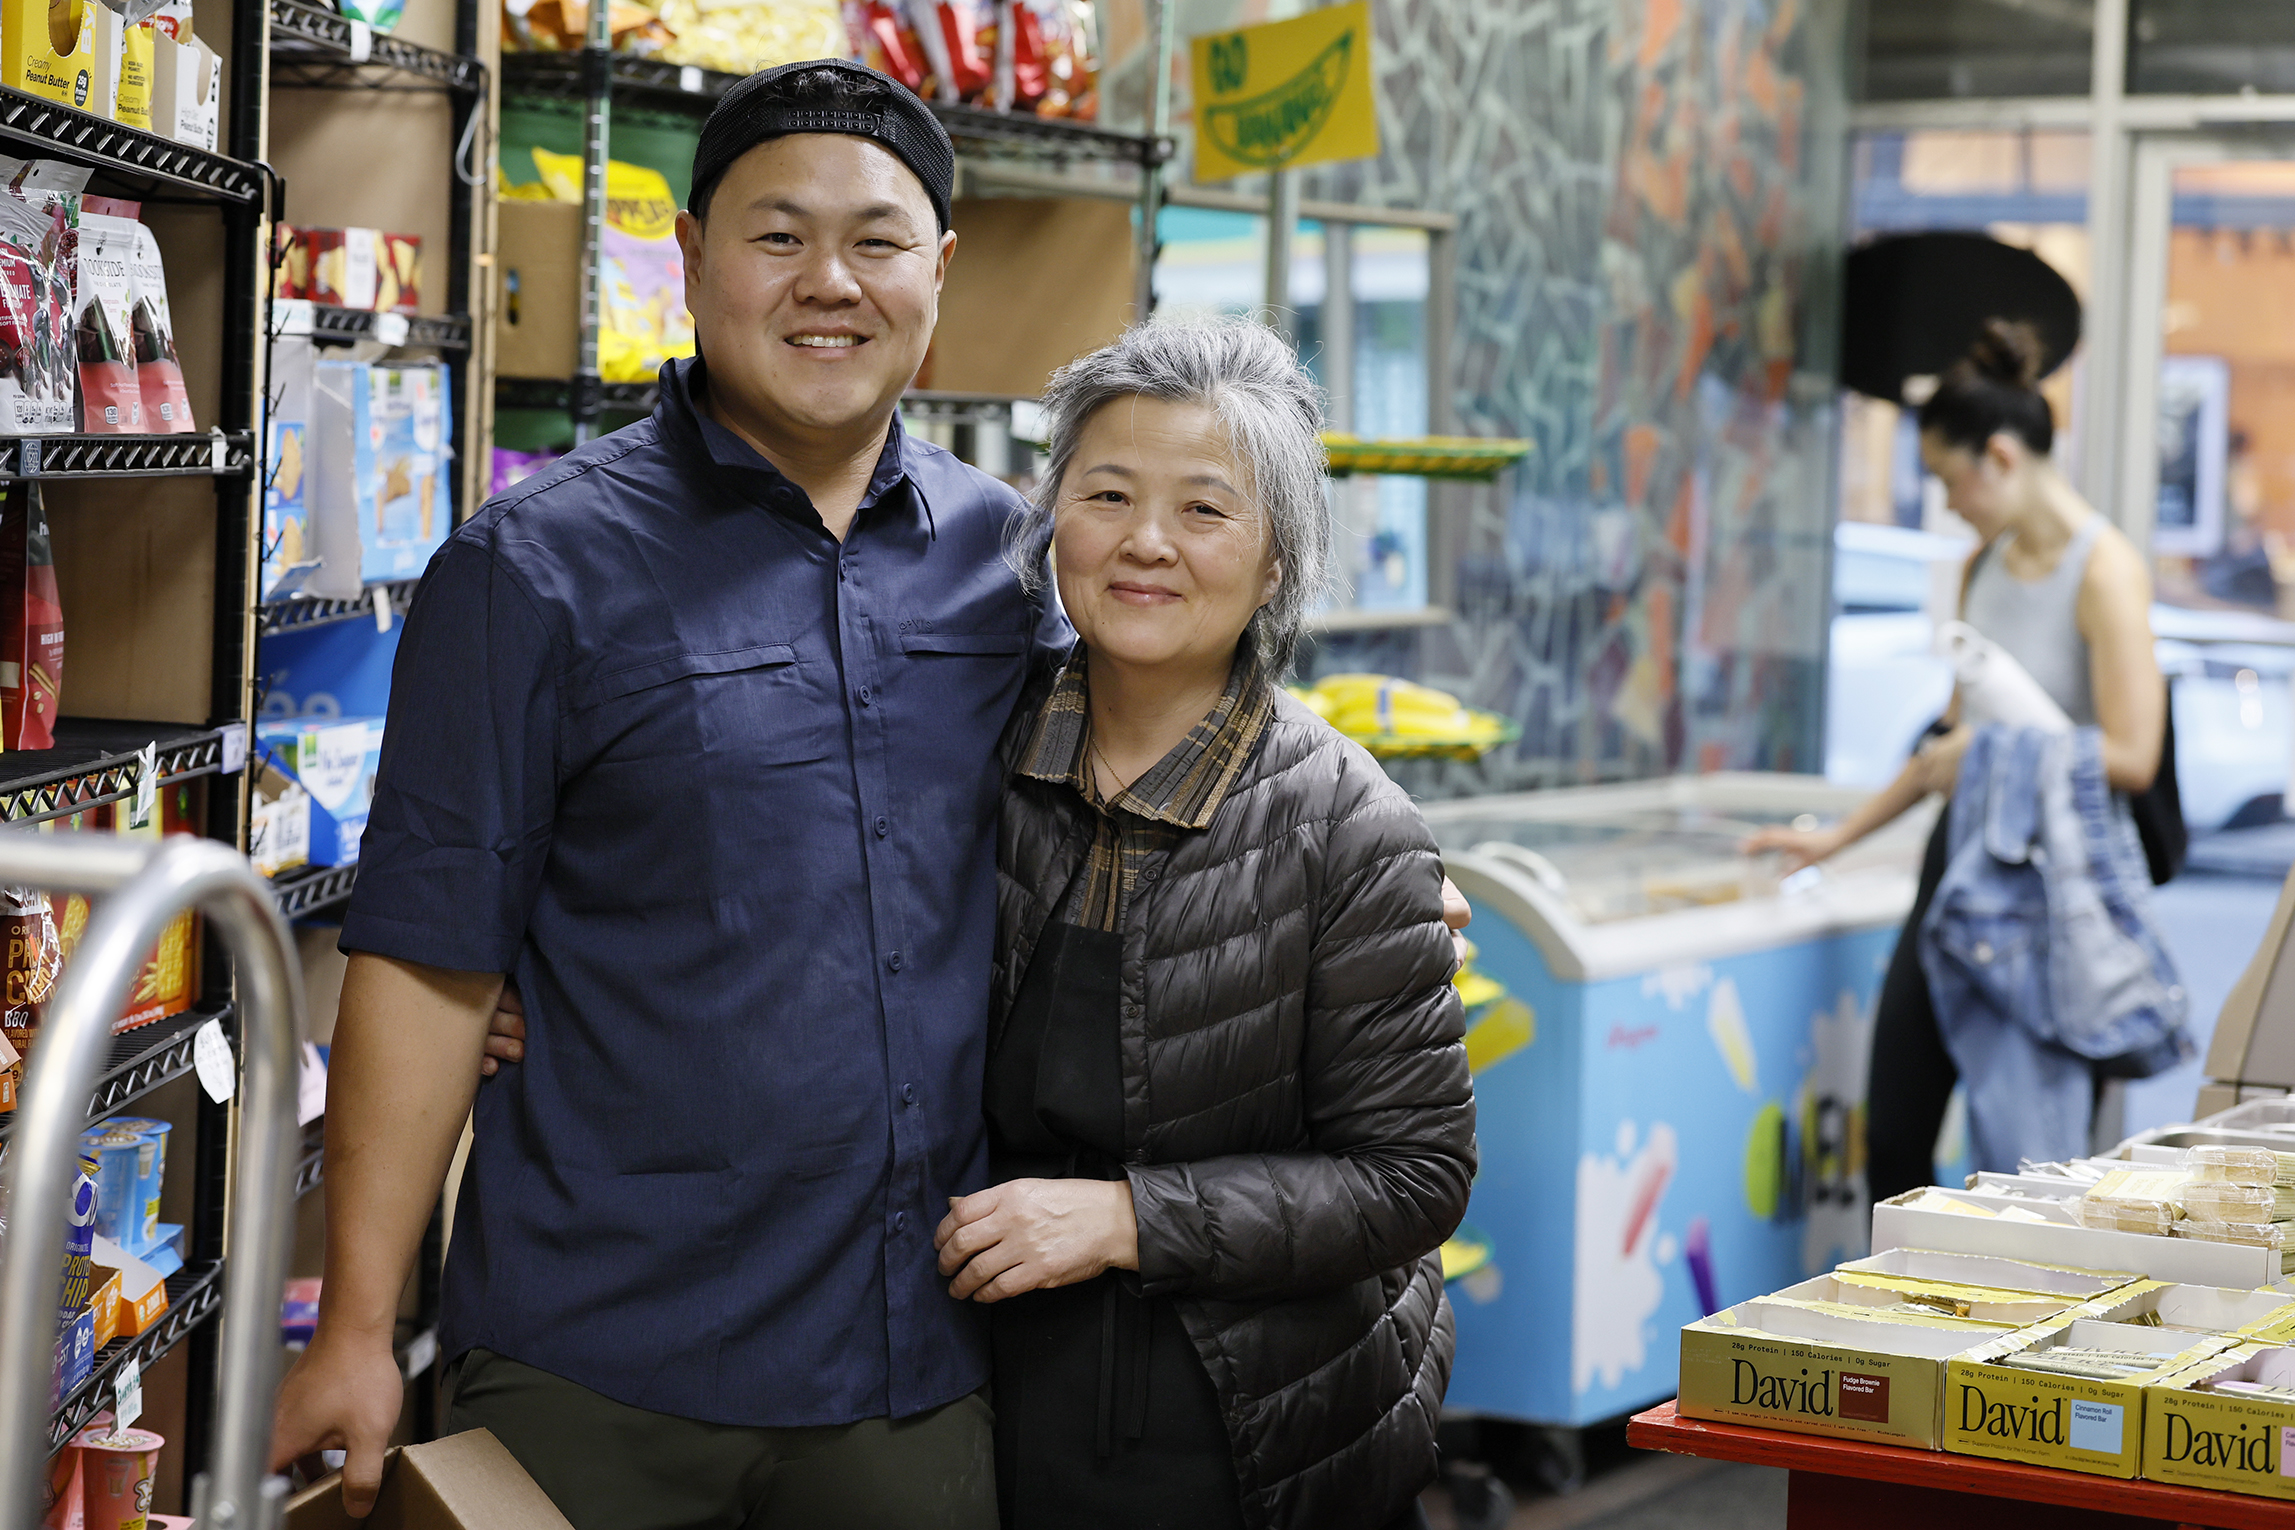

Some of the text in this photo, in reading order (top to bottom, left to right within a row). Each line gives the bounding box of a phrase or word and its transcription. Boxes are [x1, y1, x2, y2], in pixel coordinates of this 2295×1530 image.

[27, 55, 52, 73] Creamy
[1208, 32, 1248, 94] GO
[26, 70, 70, 89] Peanut Butter
[117, 104, 140, 115] Peanut
[107, 408, 117, 416] 130
[5, 1010, 29, 1029] BBQ
[9, 1039, 27, 1048] TURAL
[1732, 1342, 1745, 1351] 28g
[1748, 1343, 1778, 1354] Protein
[1808, 1351, 1842, 1361] Calories
[1868, 1359, 1891, 1367] Sugar
[1731, 1358, 1833, 1417] David
[1843, 1376, 1880, 1387] Fudge Brownie
[1843, 1384, 1864, 1393] Flavored
[1961, 1369, 1974, 1378] 28g
[1978, 1372, 2008, 1382] Protein
[2021, 1378, 2035, 1386] 150
[2039, 1380, 2074, 1391] Calories
[2102, 1389, 2124, 1398] Sugar
[1958, 1384, 2064, 1446] David
[2075, 1404, 2101, 1414] Cinnamon
[2075, 1412, 2107, 1423] Flavored Bar
[2164, 1397, 2285, 1419] 28g Protein 150 Calories
[2162, 1412, 2275, 1475] David
